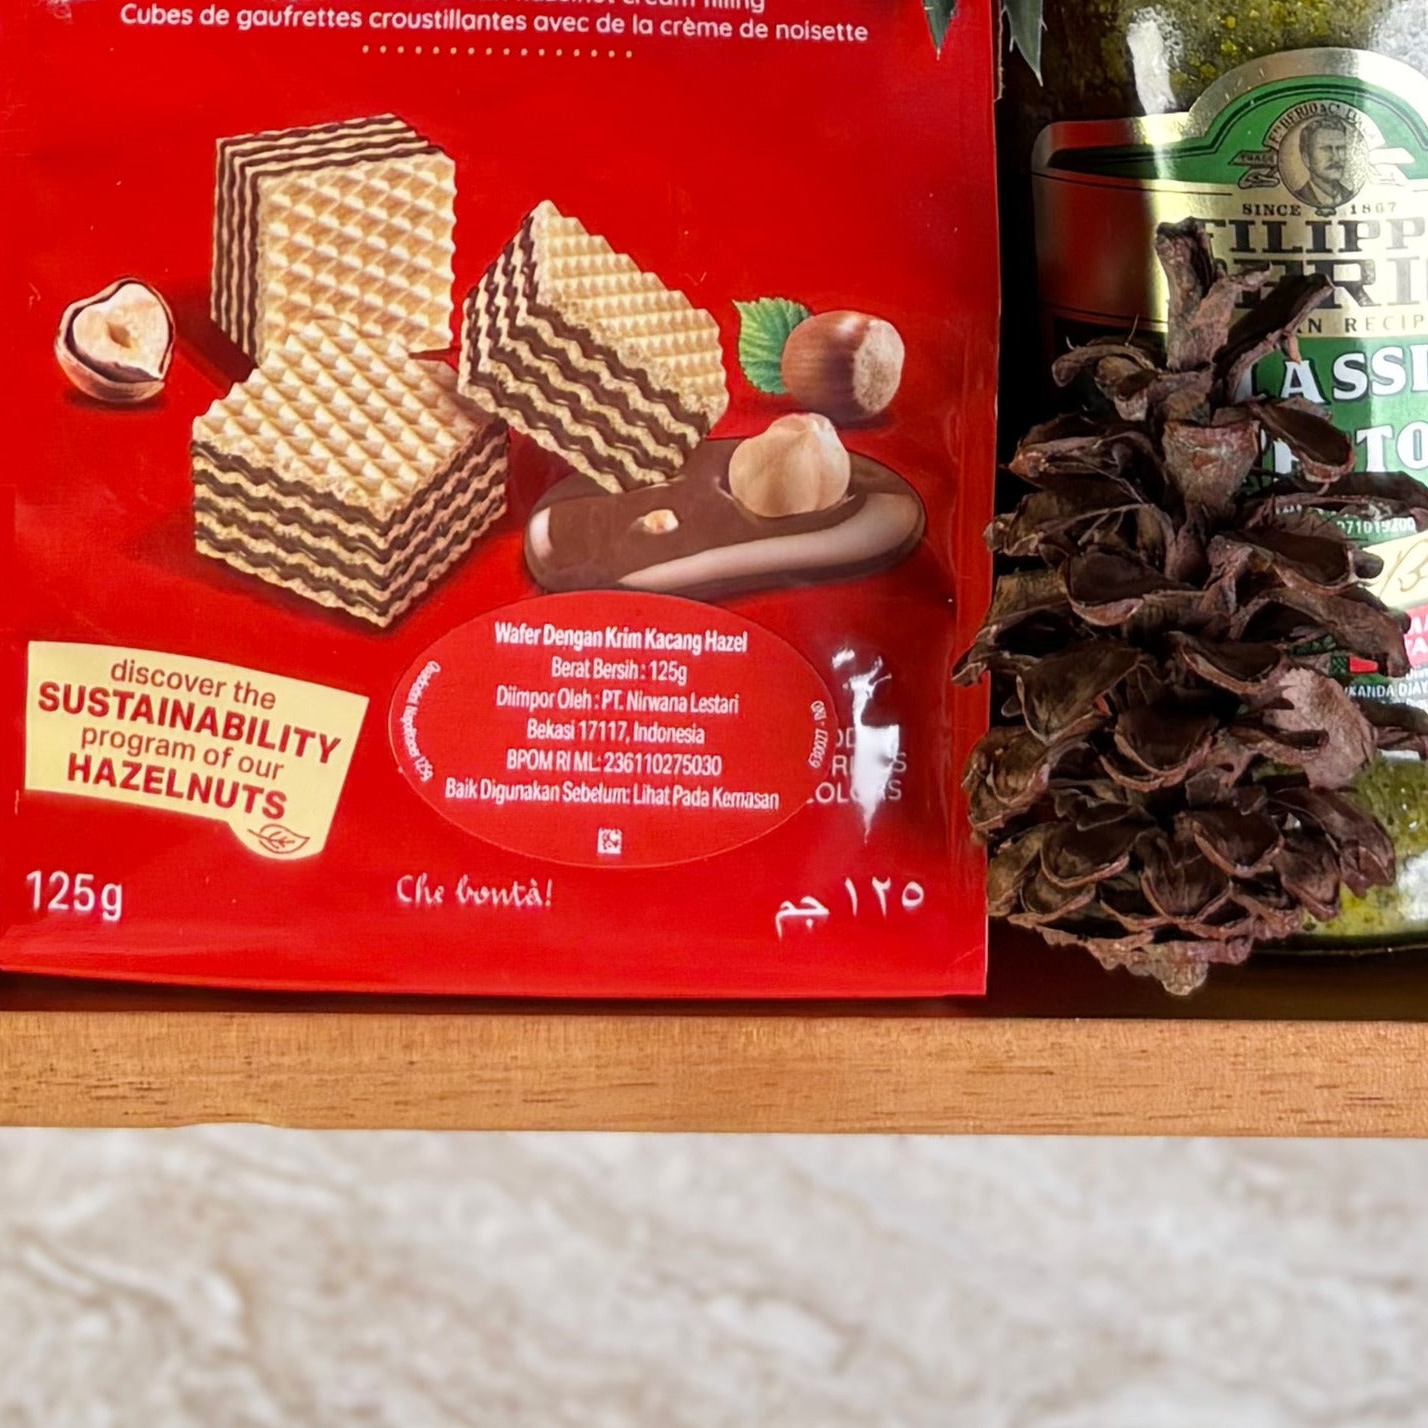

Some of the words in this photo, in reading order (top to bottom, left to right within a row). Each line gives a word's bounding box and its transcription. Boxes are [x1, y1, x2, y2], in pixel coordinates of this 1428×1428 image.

[121, 3, 193, 25] Cubes
[199, 4, 230, 26] de
[237, 5, 362, 31] gaufrettes
[369, 8, 527, 33] croustillantes
[533, 15, 589, 33] avec
[596, 12, 625, 33] de
[660, 16, 733, 38] crème
[739, 18, 768, 39] de
[775, 20, 869, 42] noisette
[494, 621, 542, 644] Wafer
[543, 624, 603, 651] Dengan
[644, 628, 702, 656] Kacang
[704, 630, 748, 653] Hazel
[110, 659, 227, 700] discover
[234, 679, 277, 710] the
[496, 685, 555, 712] Diimpor
[626, 691, 688, 713] Nirwana
[690, 693, 739, 714] Lestari
[37, 681, 342, 765] SUSTAINABILITY
[526, 718, 575, 741] Bekasi
[633, 721, 705, 745] Indonesia
[81, 725, 196, 762] program
[203, 745, 234, 768] of
[237, 756, 285, 781] our
[506, 748, 553, 770] BPOM
[603, 751, 723, 777] 236110275030
[67, 752, 289, 821] HAZELNUTS
[480, 779, 560, 805] Digunakan
[712, 786, 780, 810] Kemasan
[26, 870, 124, 922] 125g
[396, 875, 445, 906] Che
[457, 876, 553, 909] bontà!
[844, 876, 925, 918] ١٢٥
[775, 894, 830, 940] جم
